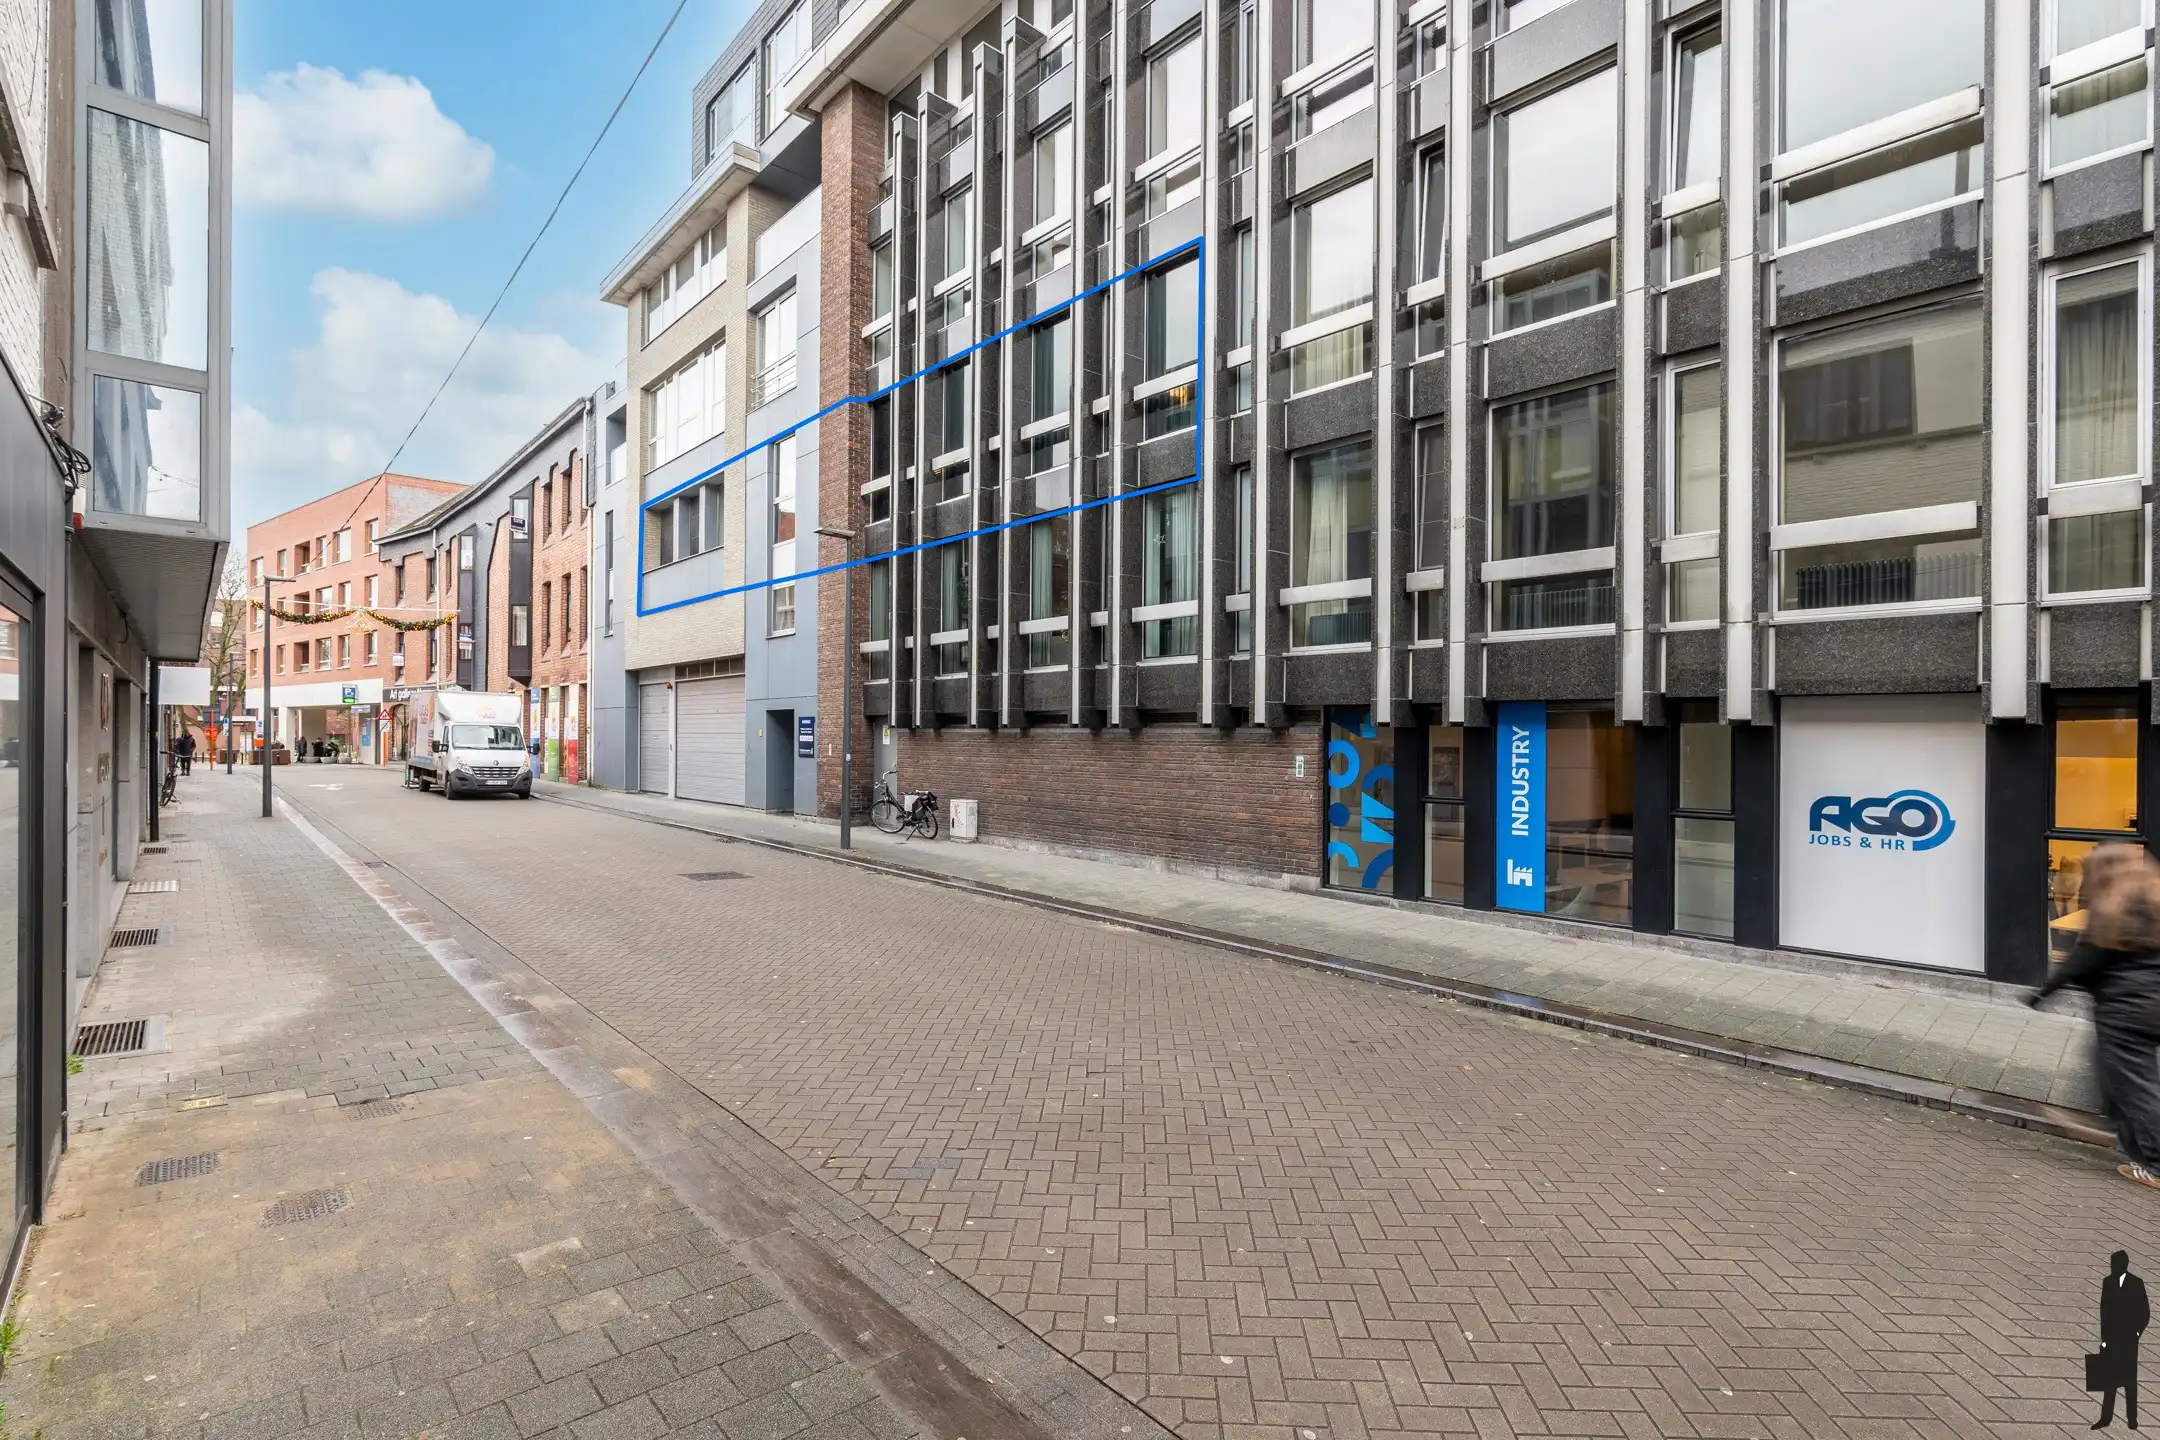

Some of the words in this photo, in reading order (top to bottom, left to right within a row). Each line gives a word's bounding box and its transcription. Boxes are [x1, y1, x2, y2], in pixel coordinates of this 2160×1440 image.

[1511, 726, 1530, 836] INDUSTRY
[1809, 795, 1938, 838] AGO
[1809, 833, 1852, 847] JOBS
[1859, 836, 1872, 849] &
[1881, 838, 1905, 851] HR
